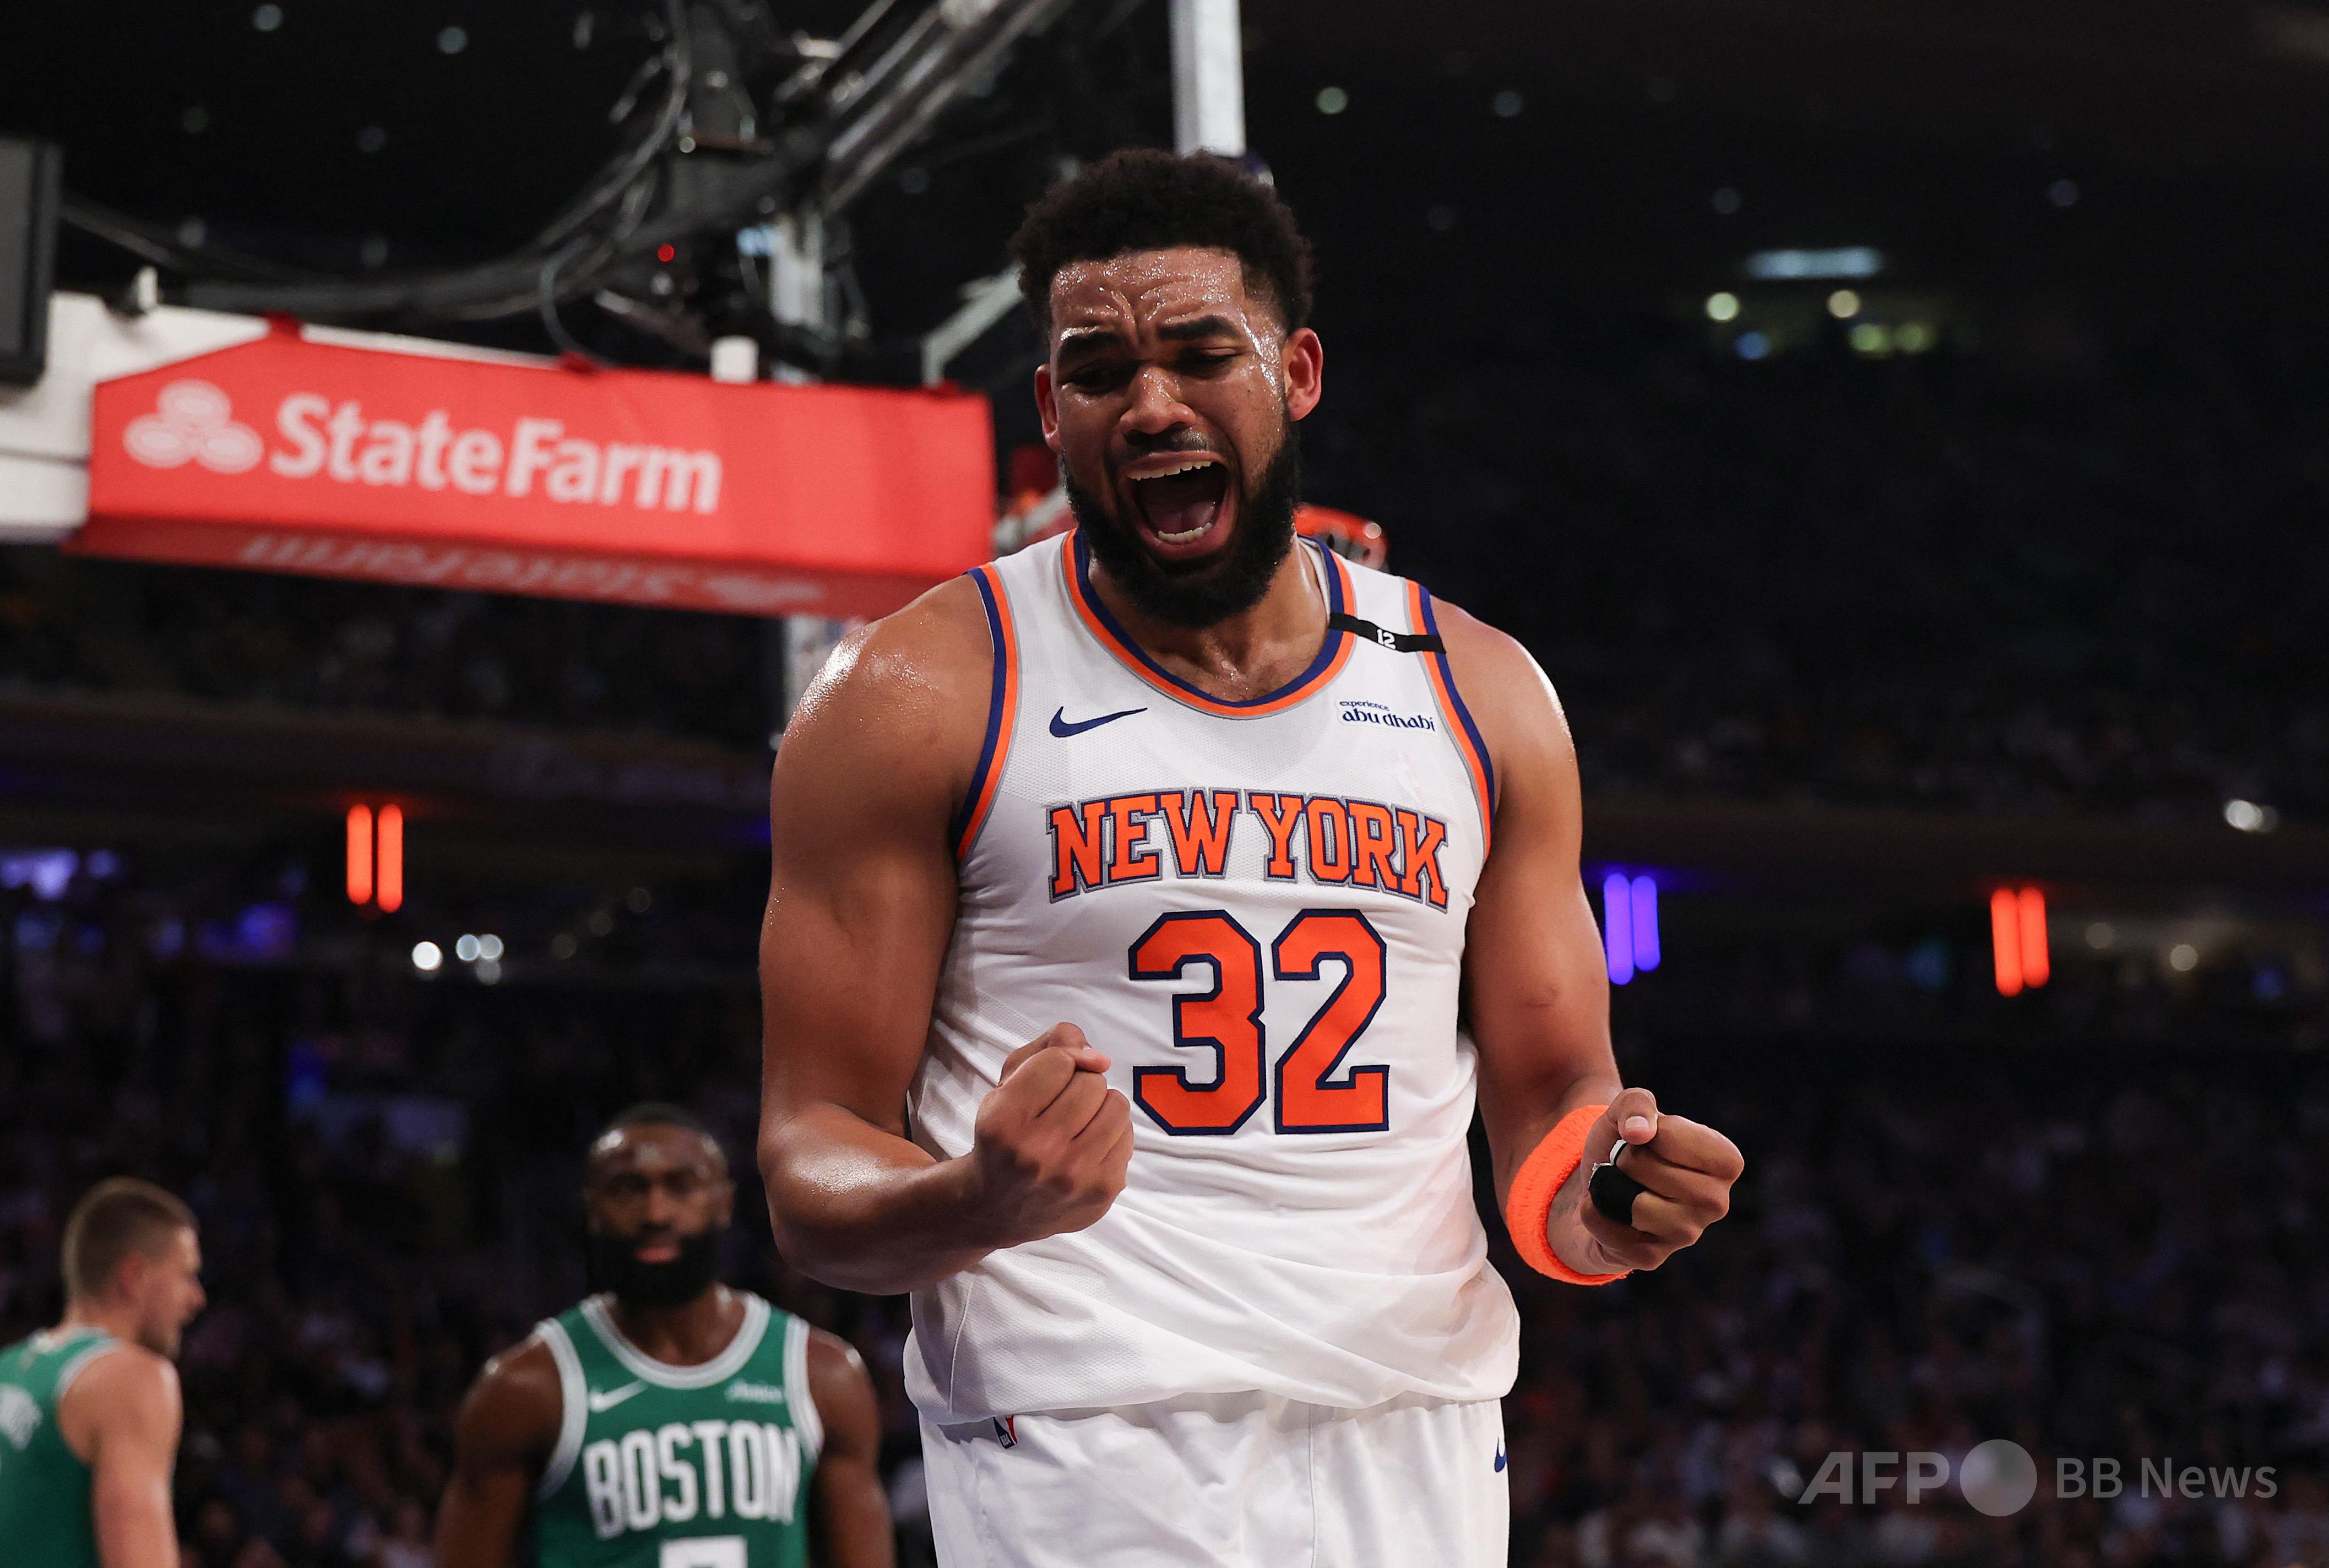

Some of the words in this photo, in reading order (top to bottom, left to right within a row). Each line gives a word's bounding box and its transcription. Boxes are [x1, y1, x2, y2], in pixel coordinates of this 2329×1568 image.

[270, 393, 723, 513] StateFarm
[1377, 628, 1396, 649] 12
[1339, 701, 1390, 711] experience
[1342, 708, 1380, 724] abu
[1382, 714, 1435, 731] dhabi
[1046, 788, 1242, 903] NEW
[1245, 789, 1449, 913] YORK
[1128, 909, 1389, 1135] 32
[584, 1420, 802, 1540] BOSTON
